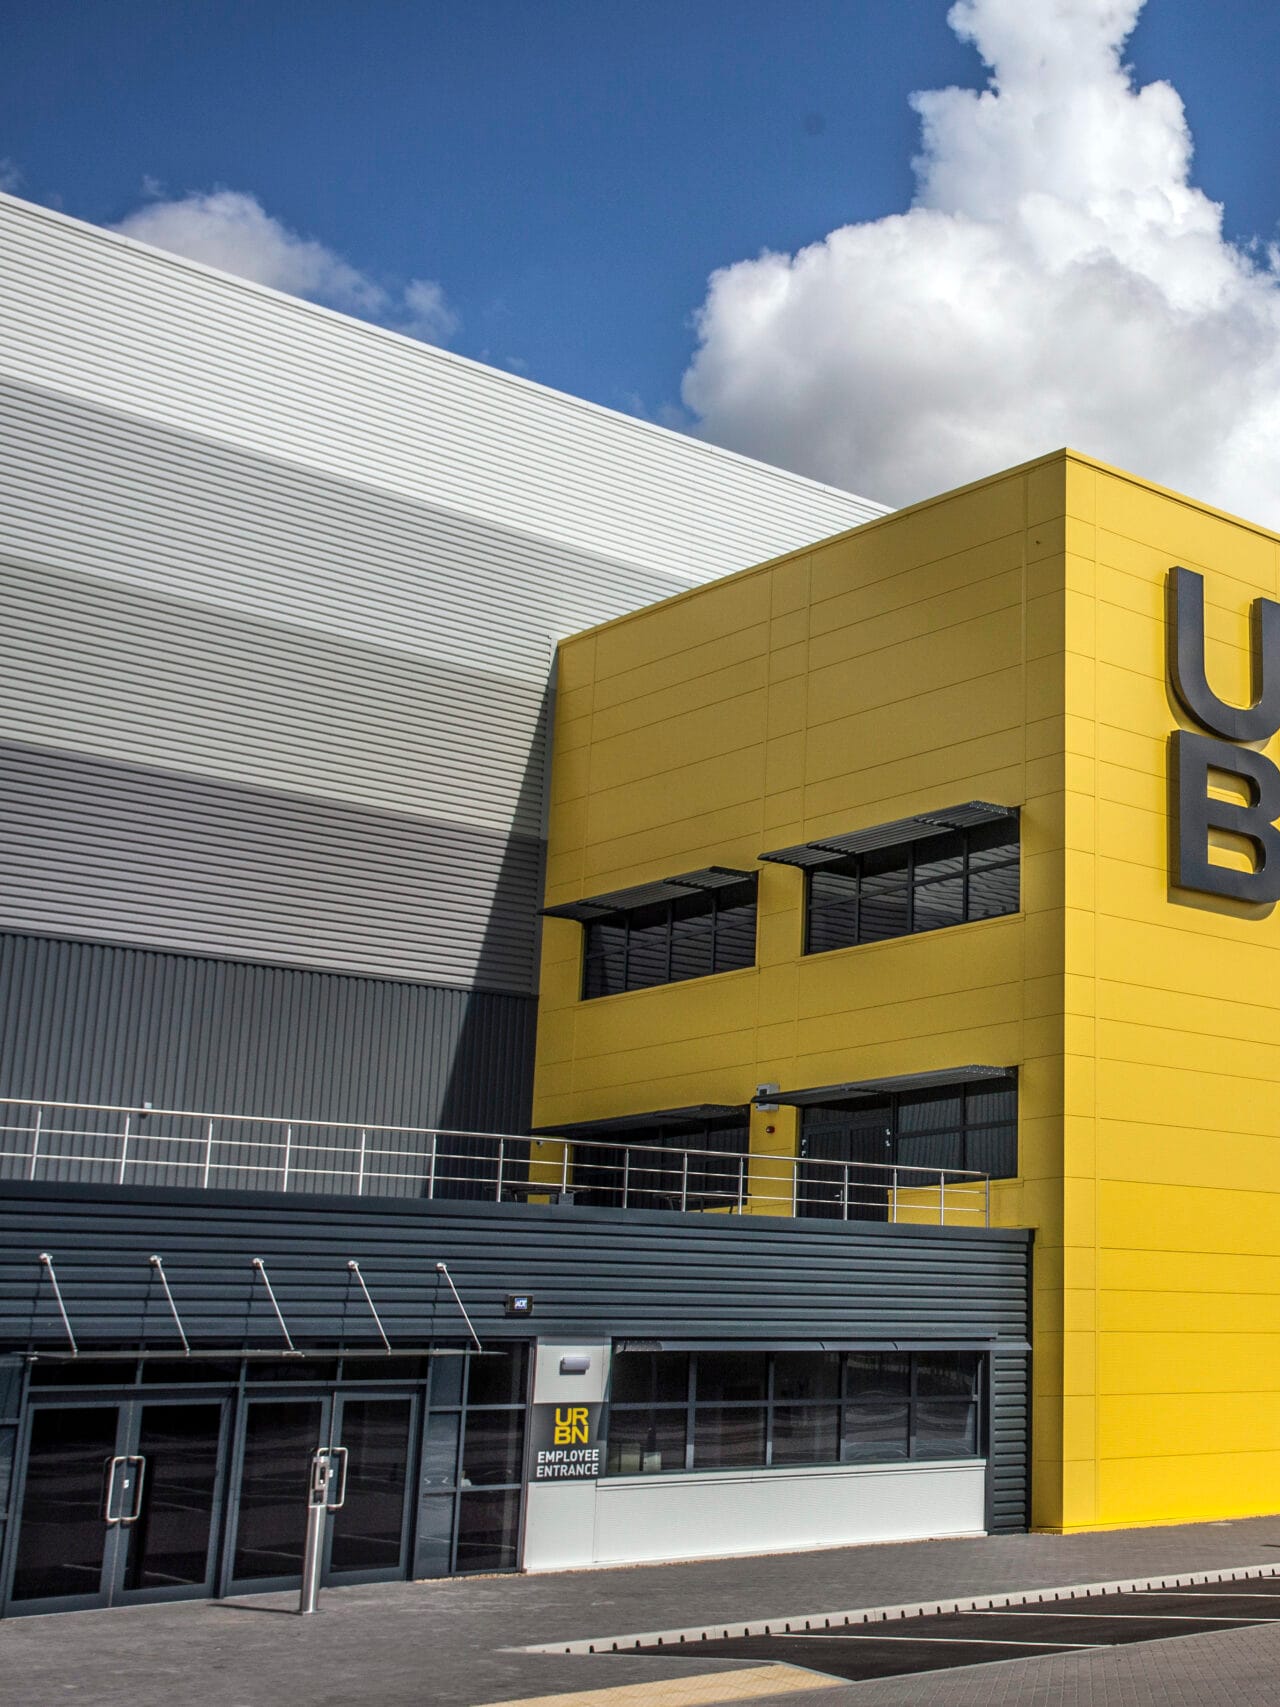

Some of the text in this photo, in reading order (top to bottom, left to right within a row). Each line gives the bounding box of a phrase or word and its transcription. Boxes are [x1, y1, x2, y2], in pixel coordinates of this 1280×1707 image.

[555, 1407, 589, 1426] UR
[554, 1425, 589, 1445] BN
[537, 1449, 600, 1464] EMPLOYEE
[536, 1463, 599, 1478] ENTRANCE
